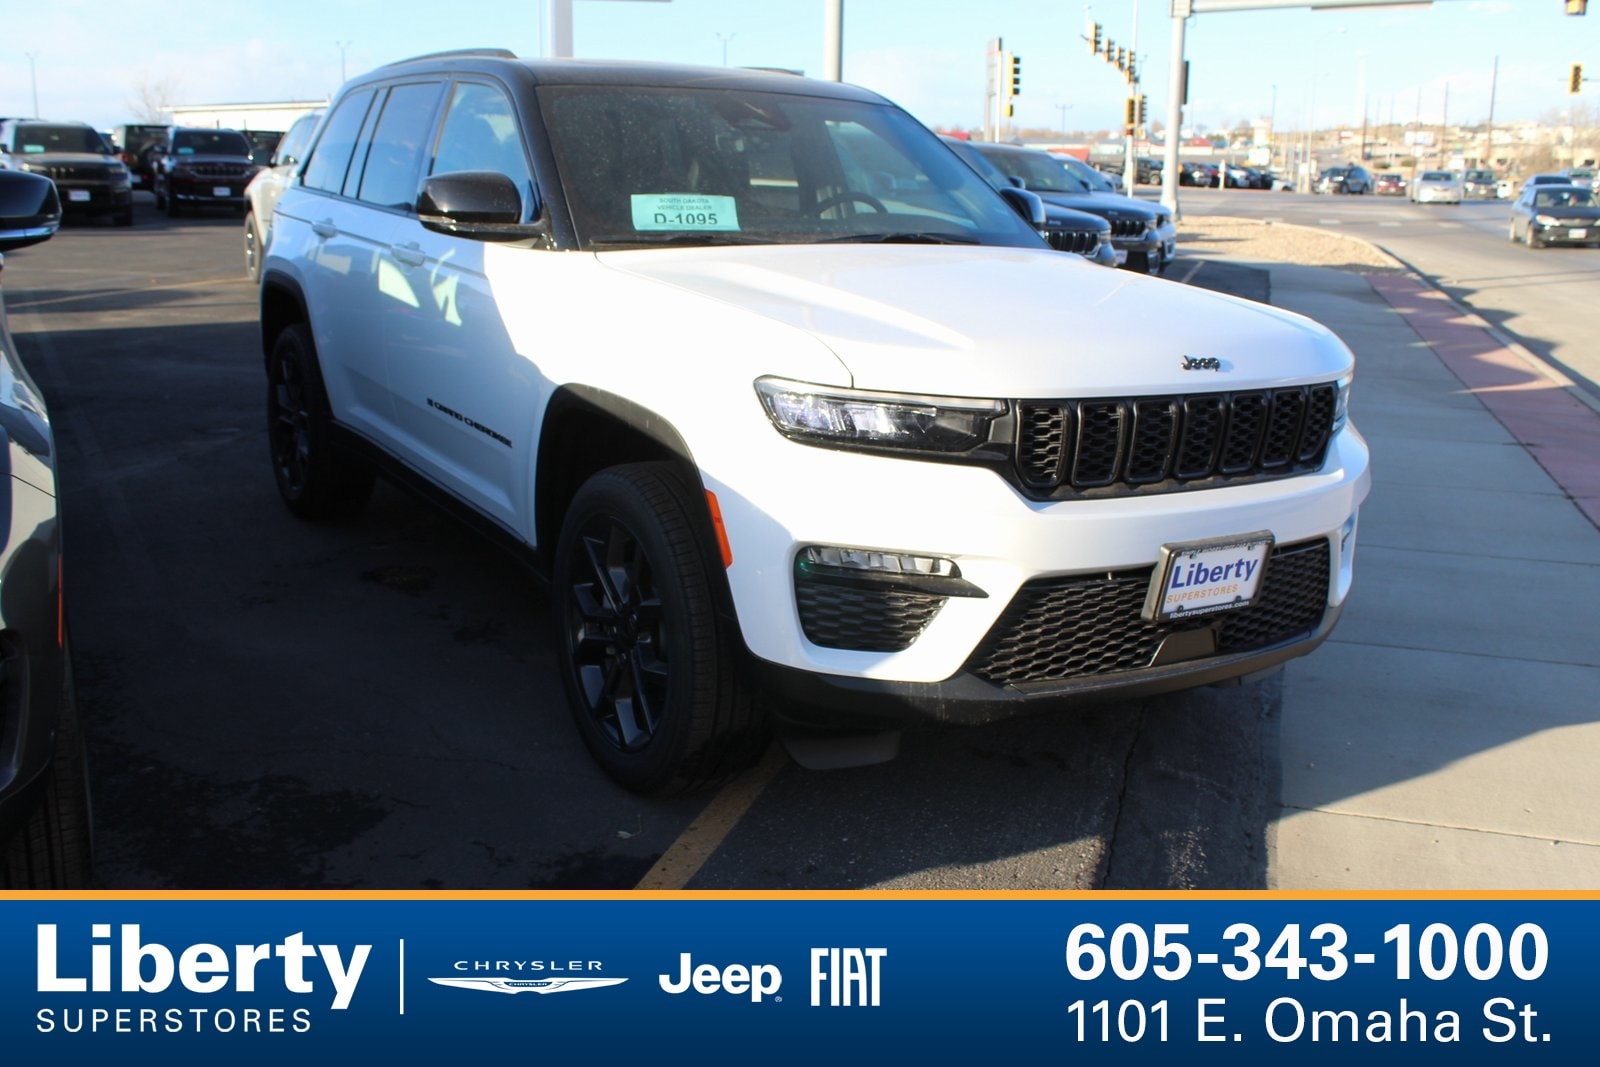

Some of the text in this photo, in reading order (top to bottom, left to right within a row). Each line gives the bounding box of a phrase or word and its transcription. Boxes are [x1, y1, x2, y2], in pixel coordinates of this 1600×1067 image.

[654, 213, 718, 225] D-1095
[1180, 355, 1221, 372] Jeep
[1171, 558, 1258, 589] Liberty
[1167, 584, 1238, 604] SUPERSTORES
[1169, 601, 1250, 619] libertysuperstores.com
